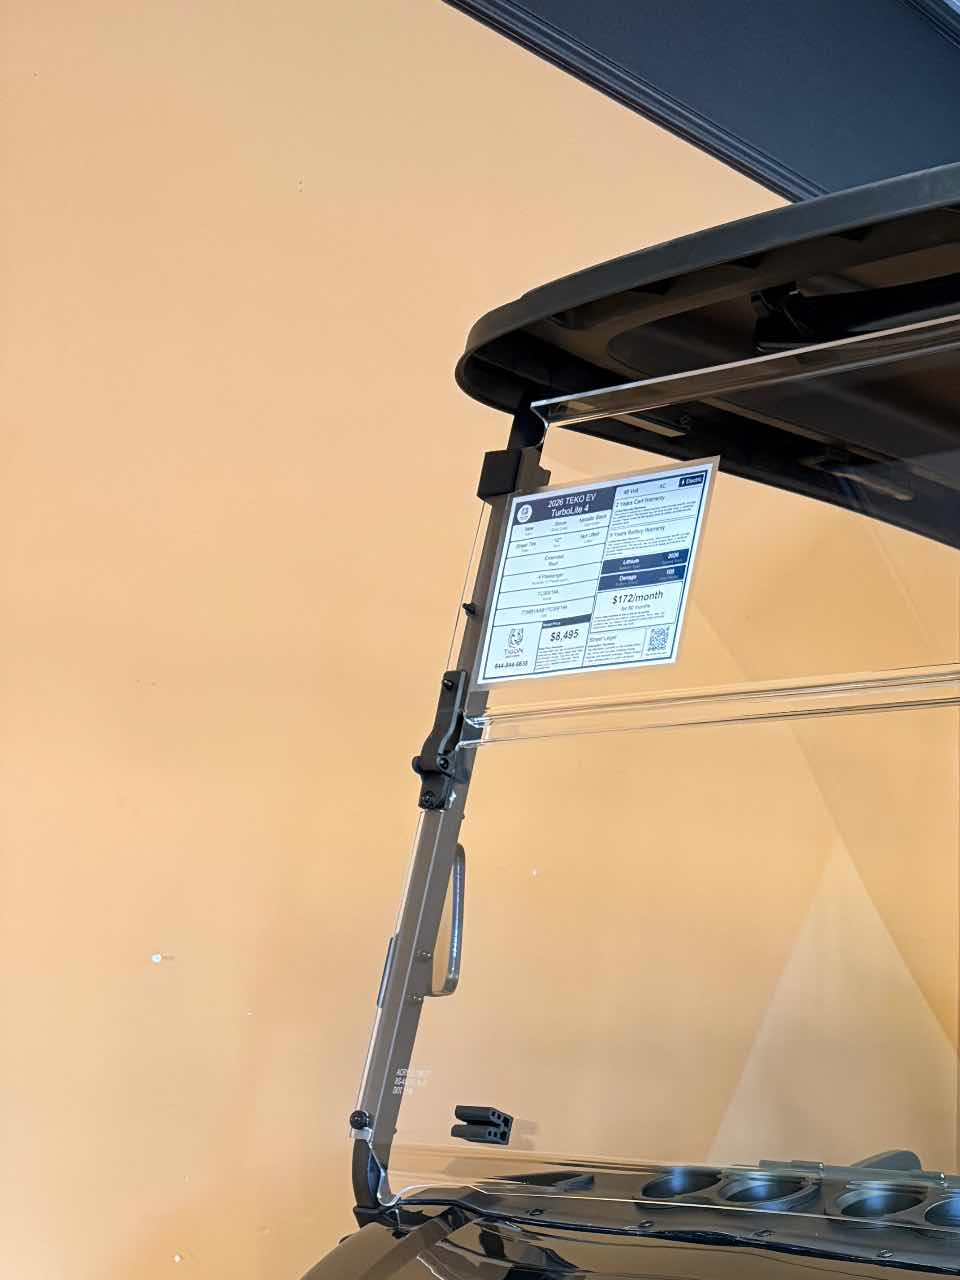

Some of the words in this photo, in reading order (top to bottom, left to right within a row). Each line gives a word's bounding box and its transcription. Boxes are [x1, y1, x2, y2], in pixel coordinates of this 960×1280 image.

[548, 498, 564, 508] 2026
[565, 496, 584, 505] TEKO
[586, 493, 596, 502] EV
[551, 506, 582, 517] TurboLite
[584, 504, 590, 512] 4
[612, 590, 663, 605] $172/month
[550, 629, 579, 642] $8,495
